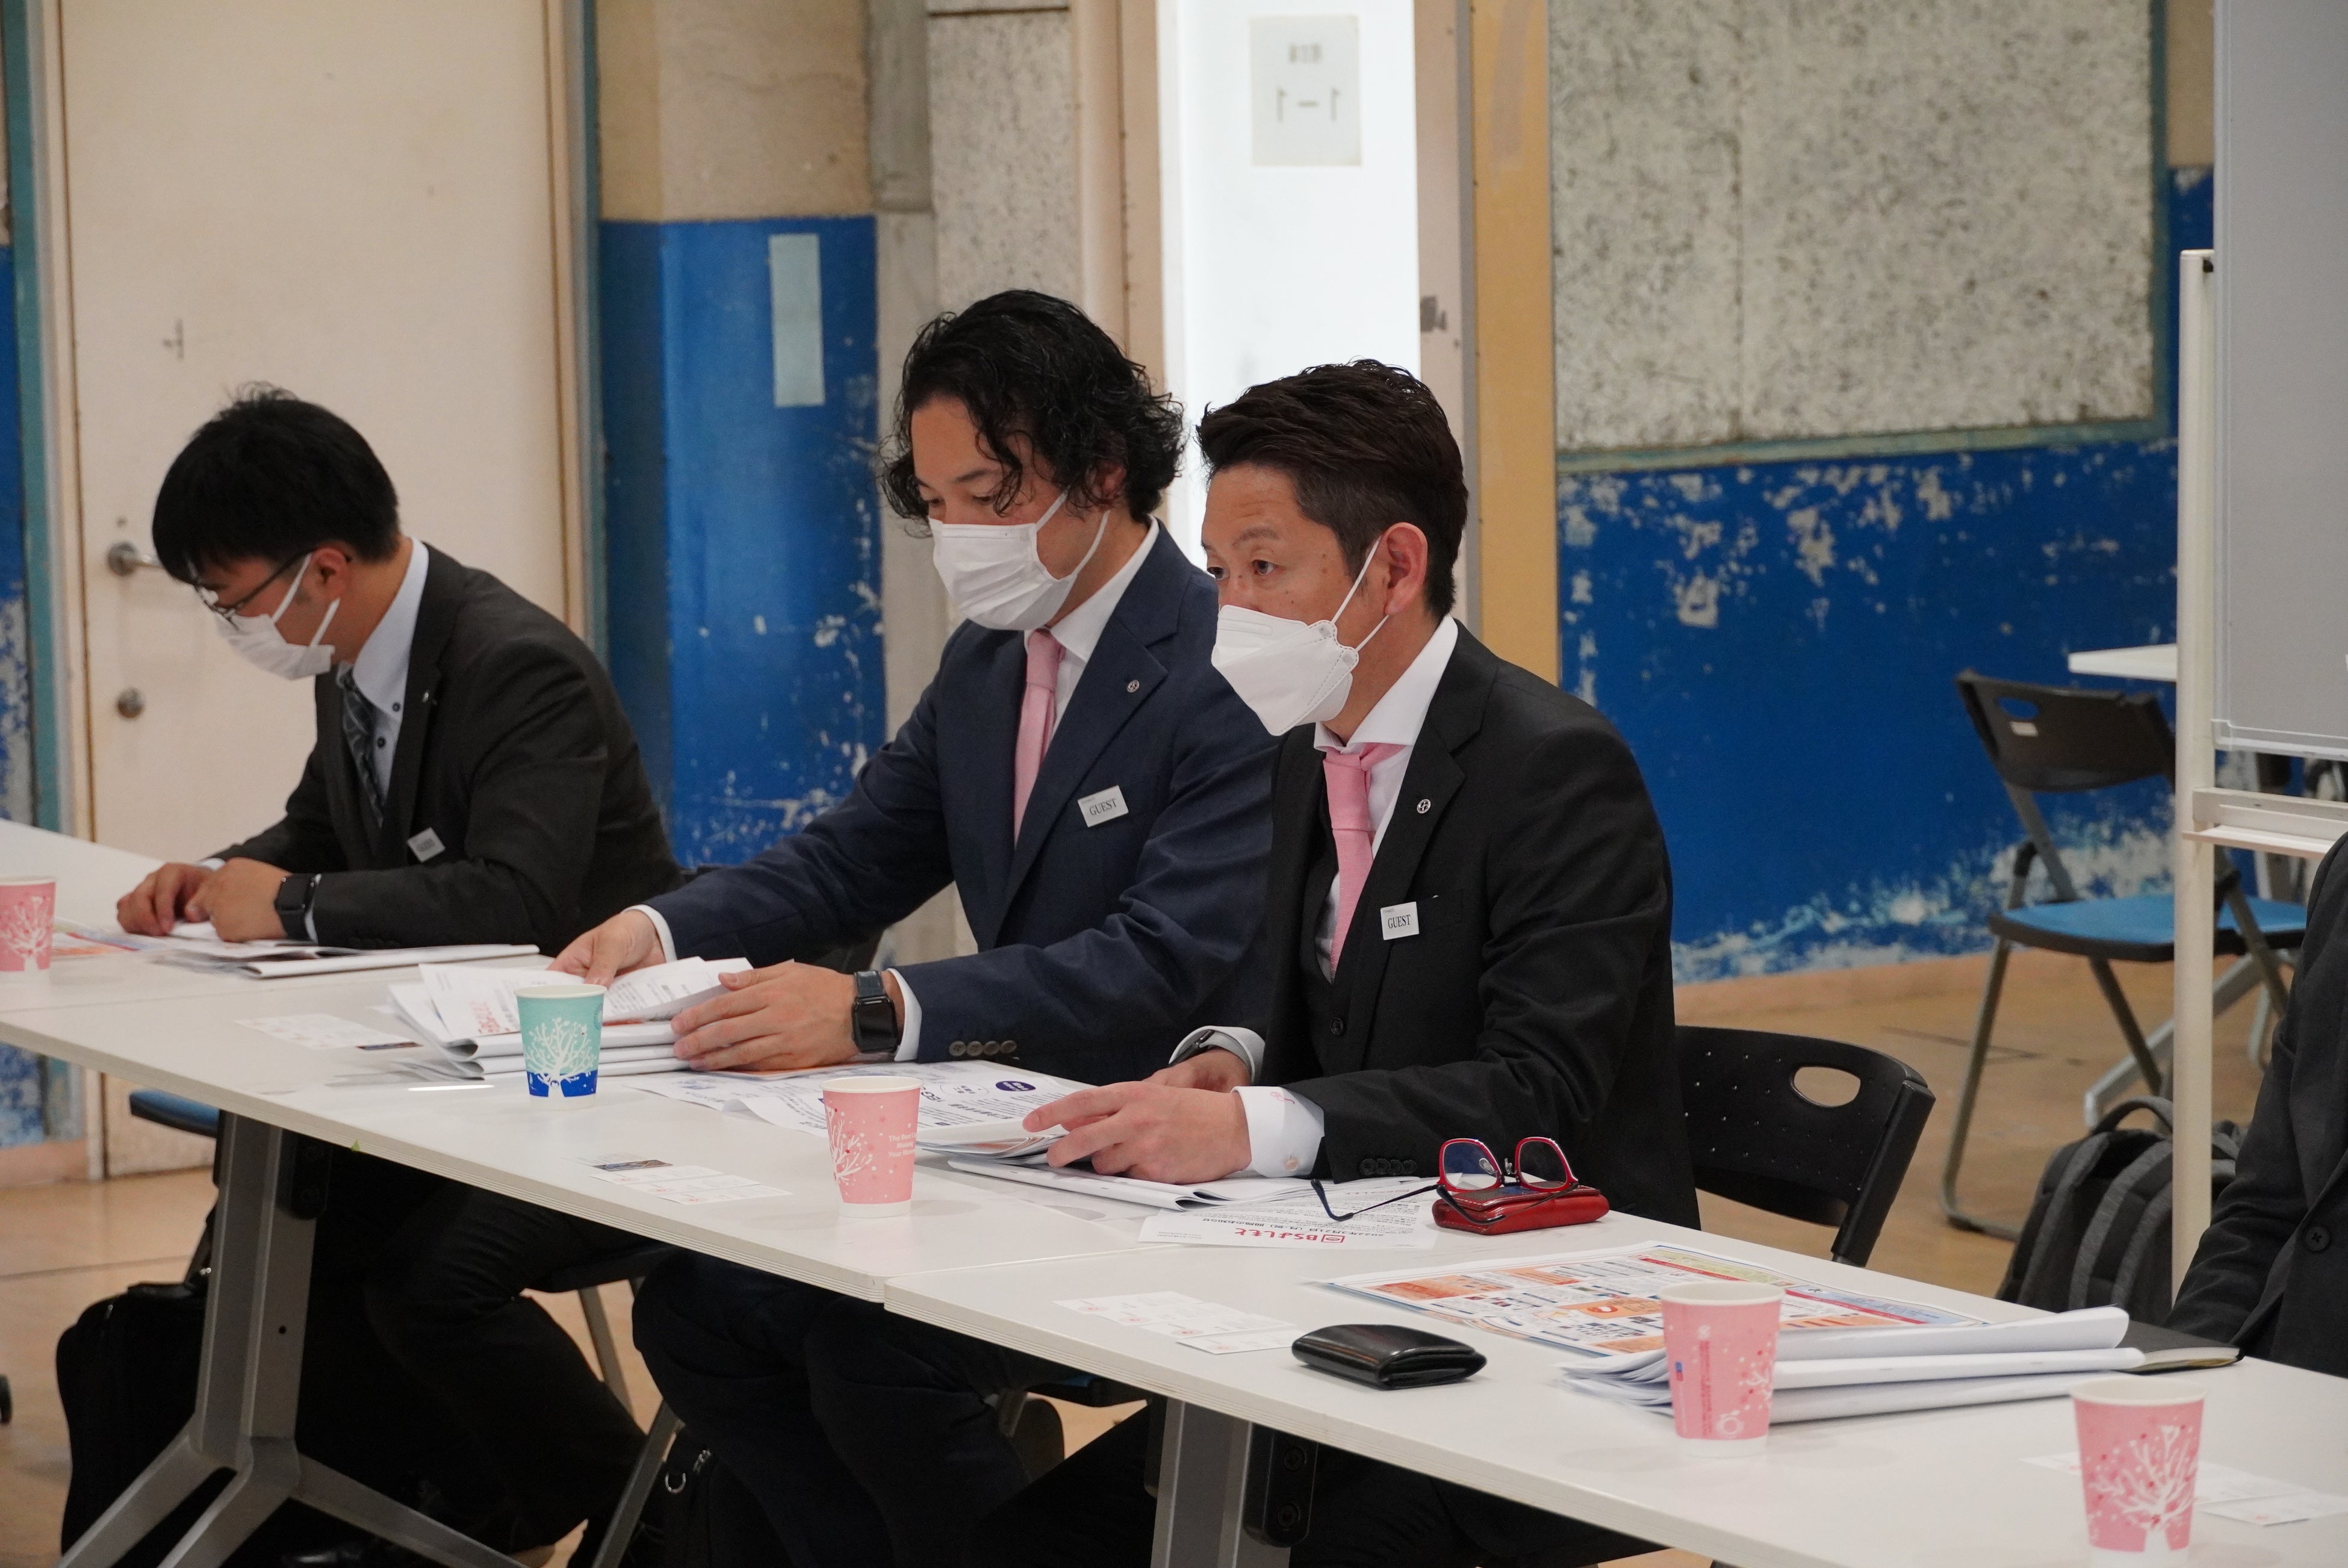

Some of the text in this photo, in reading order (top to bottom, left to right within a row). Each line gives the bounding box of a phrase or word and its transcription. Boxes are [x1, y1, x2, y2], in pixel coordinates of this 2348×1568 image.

[1089, 798, 1117, 816] GUEST
[1388, 914, 1411, 929] GUEST
[1235, 1227, 1318, 1241] BSよしもと
